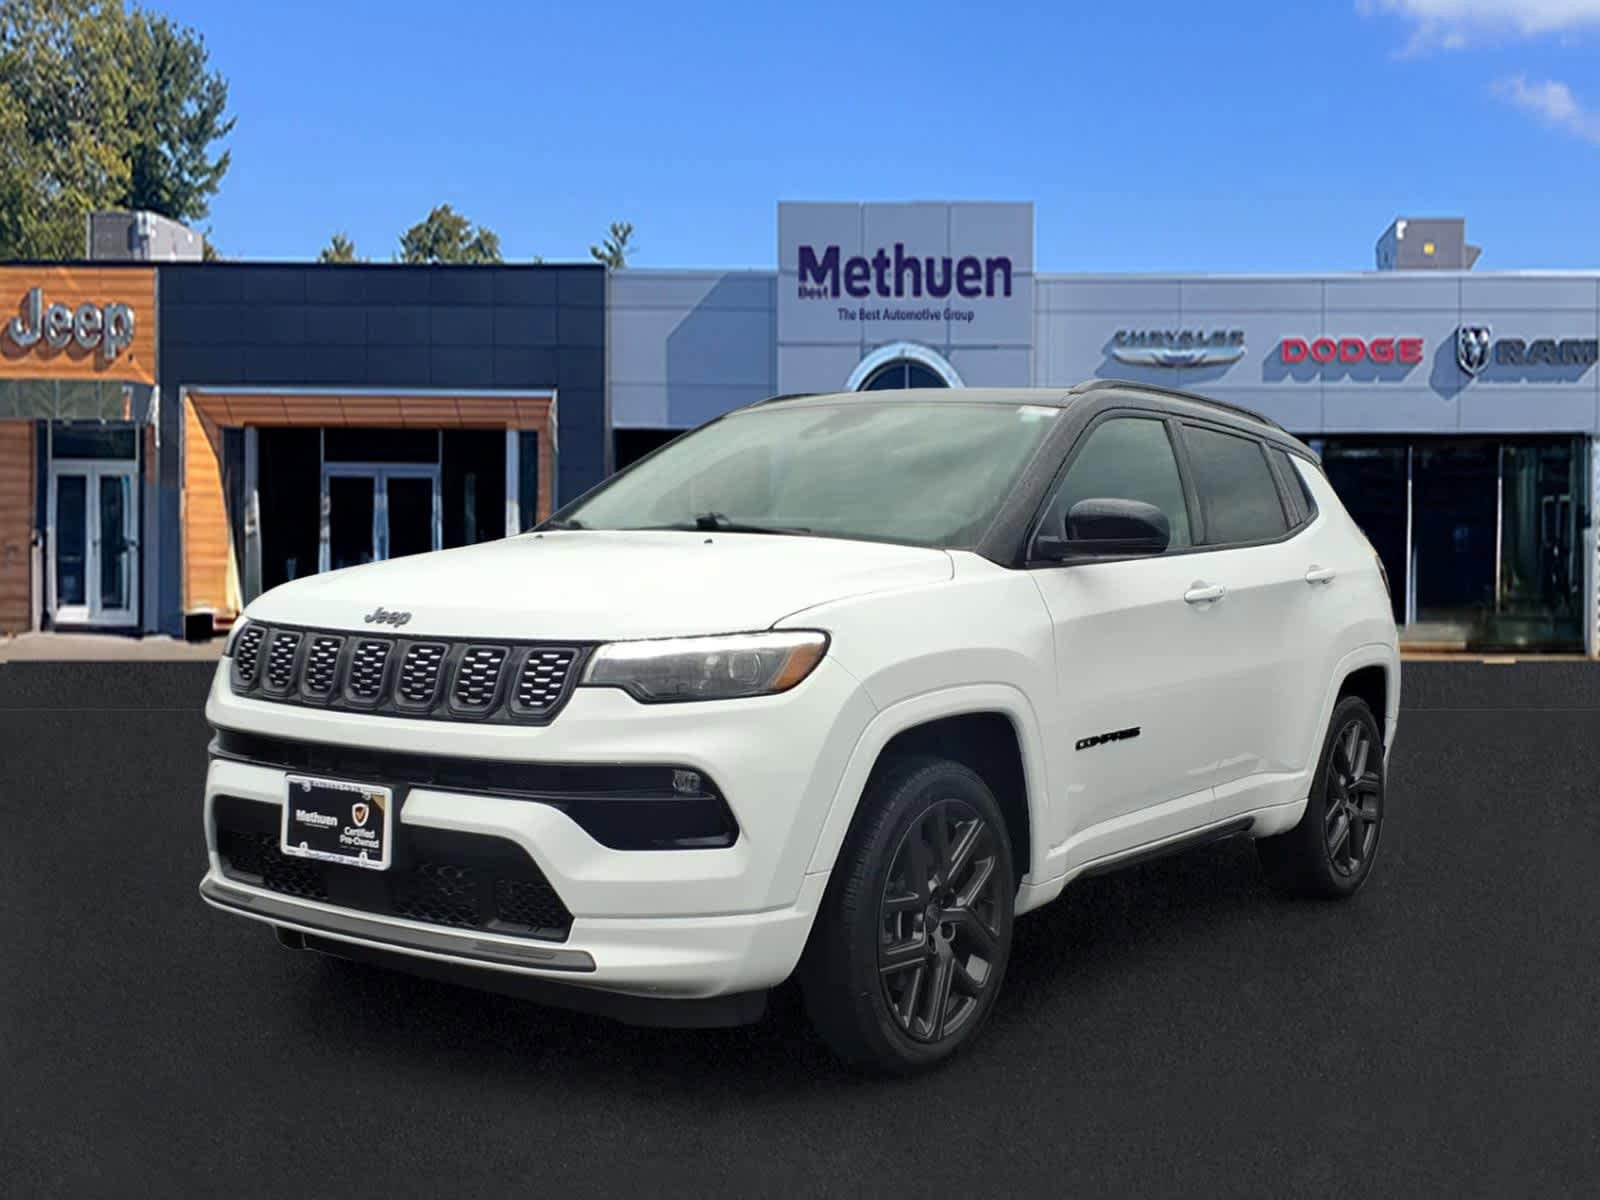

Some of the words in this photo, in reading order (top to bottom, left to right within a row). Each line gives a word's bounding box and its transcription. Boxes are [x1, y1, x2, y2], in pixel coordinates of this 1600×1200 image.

[798, 242, 1012, 298] Methuen
[9, 287, 135, 359] Jeep
[838, 308, 857, 320] The
[859, 308, 880, 320] Best
[883, 308, 941, 320] Automotive
[943, 308, 974, 323] Group
[1114, 330, 1245, 346] CHRYSLER
[1281, 337, 1424, 363] DODGE
[1496, 338, 1599, 364] RAM
[364, 606, 412, 628] Jeep
[1075, 726, 1141, 750] COMPASS
[296, 809, 338, 827] Methuen
[340, 834, 379, 848] Pre-Owned
[344, 827, 375, 839] Certified
